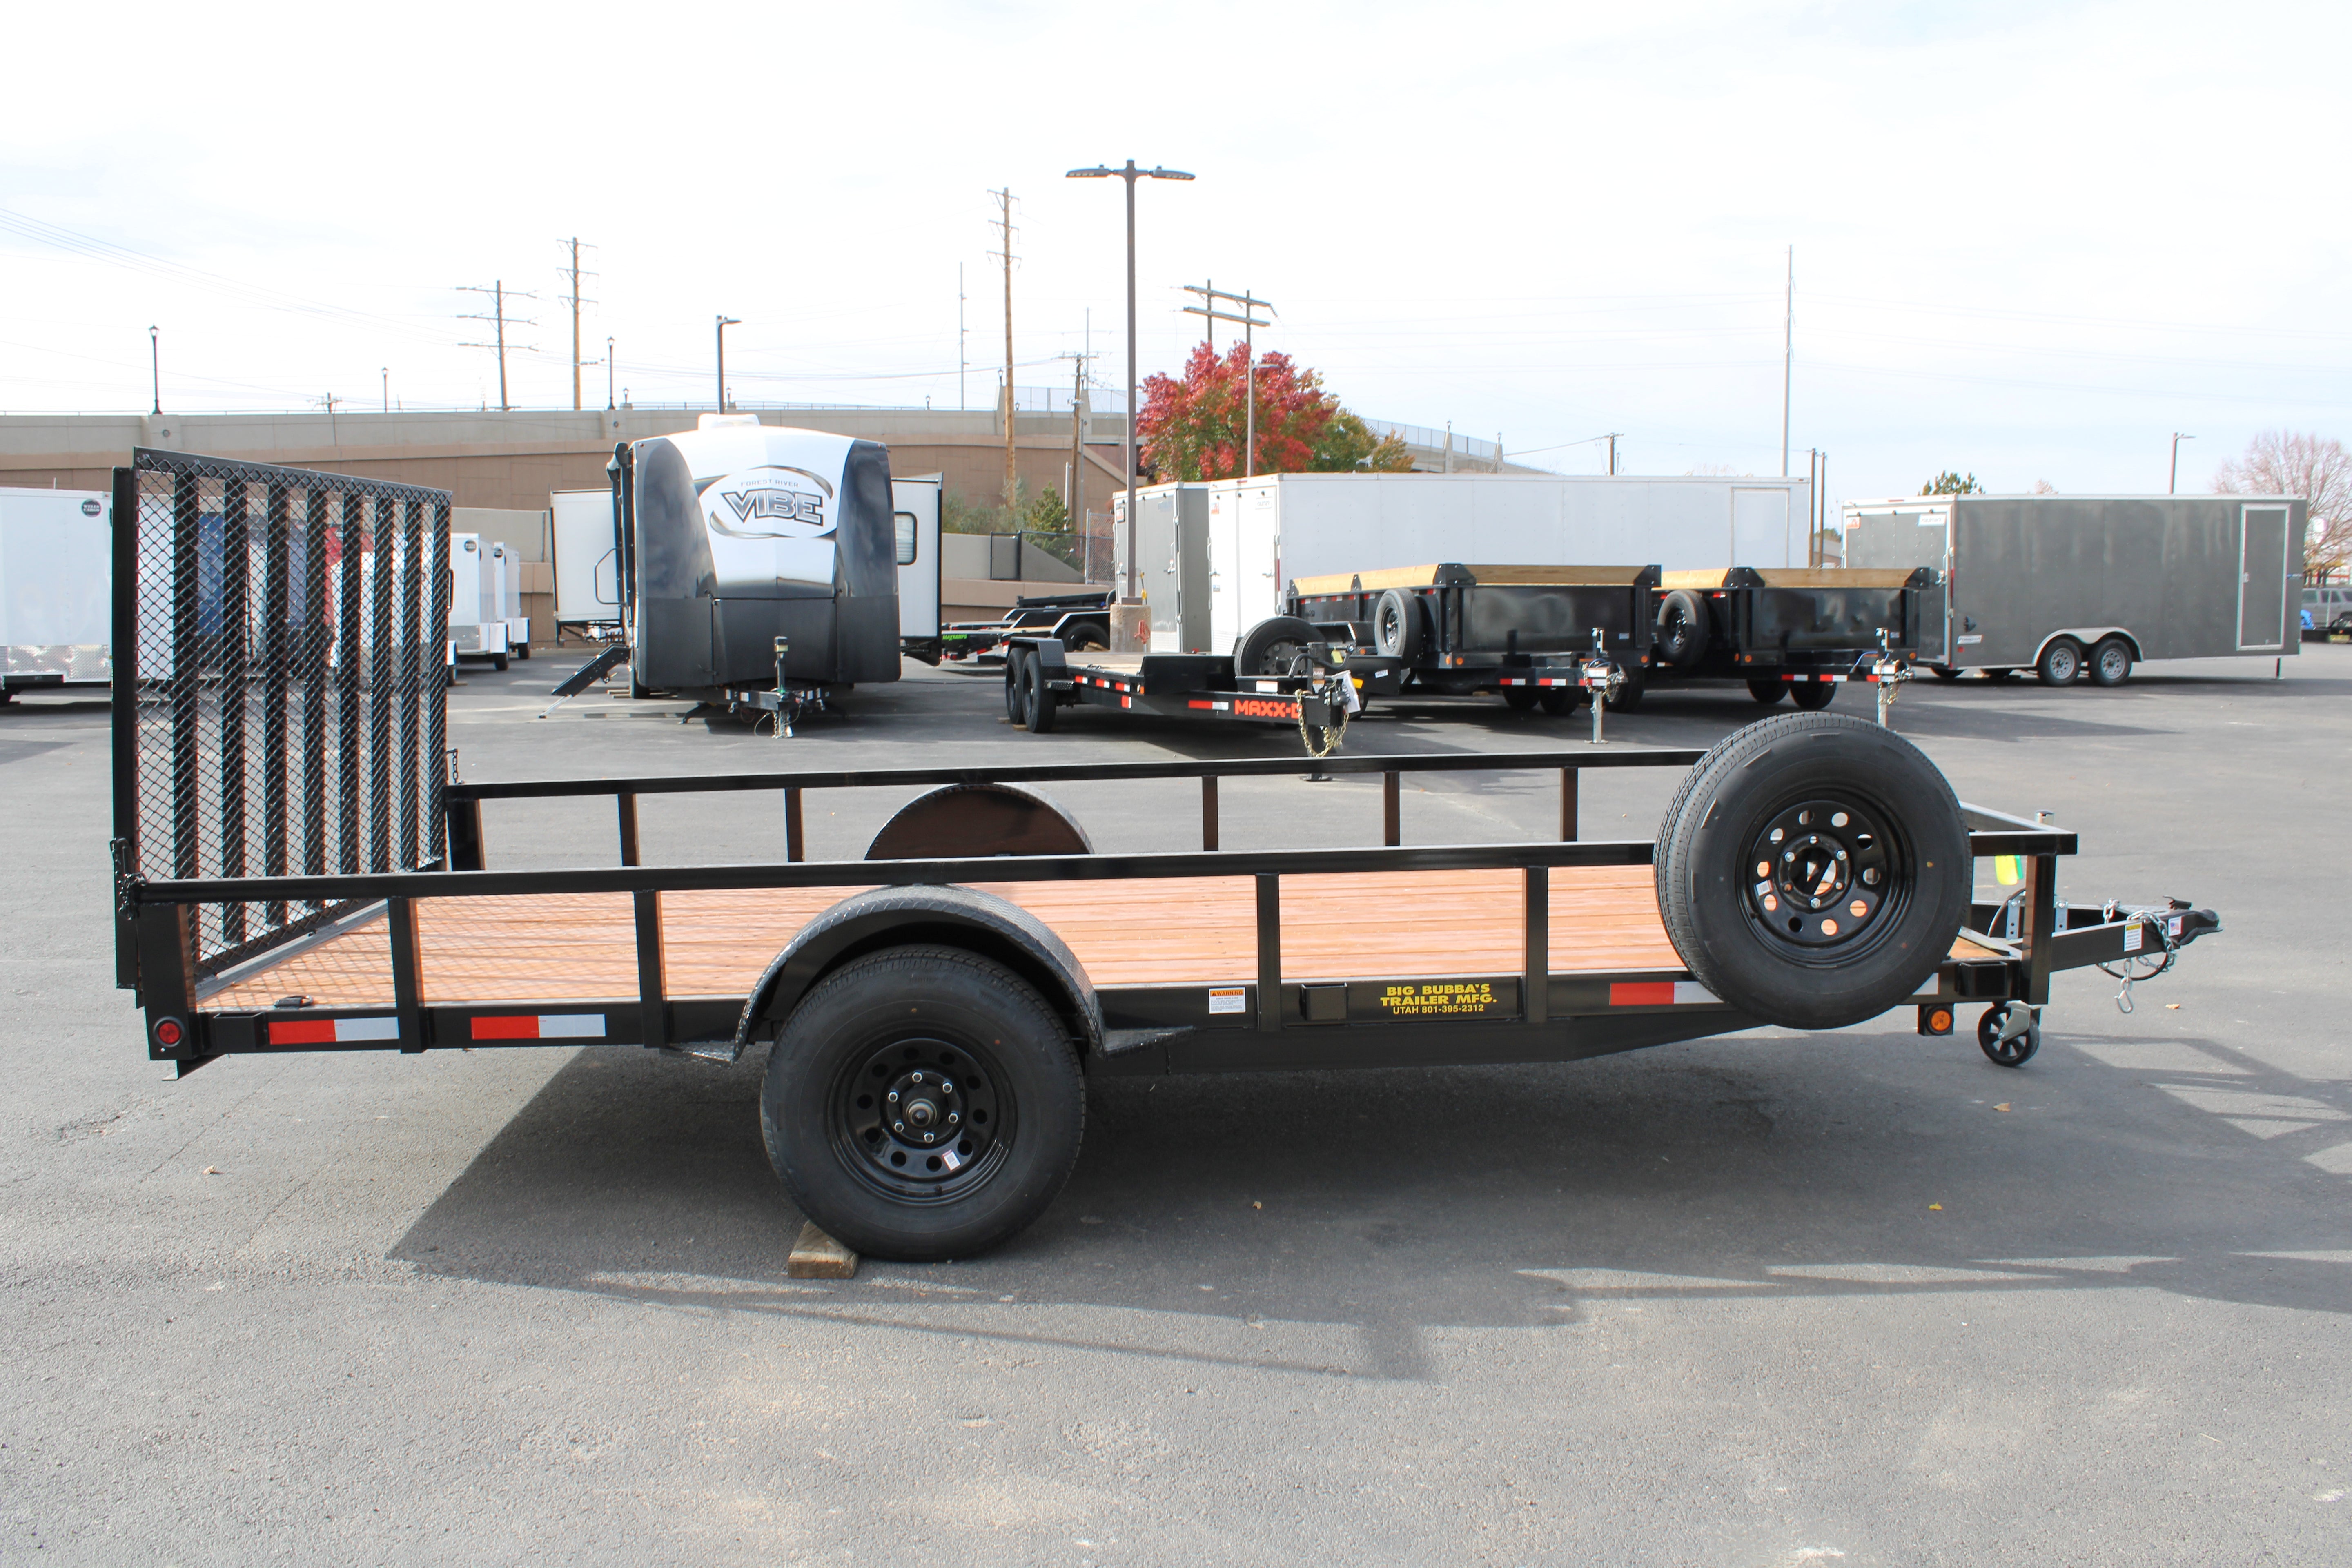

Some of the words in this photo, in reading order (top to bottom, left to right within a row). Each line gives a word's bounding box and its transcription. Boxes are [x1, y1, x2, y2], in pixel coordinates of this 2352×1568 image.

[741, 479, 773, 487] FOREST
[775, 479, 799, 488] RIVER
[720, 488, 824, 527] VIBE
[1387, 986, 1415, 996] BIG
[1422, 983, 1490, 995] BUBBA'S
[1380, 995, 1449, 1006] TRAILER
[1456, 993, 1497, 1004] MFG.
[1393, 1006, 1419, 1015] UTAH
[1422, 1004, 1484, 1013] 801-395-2312
